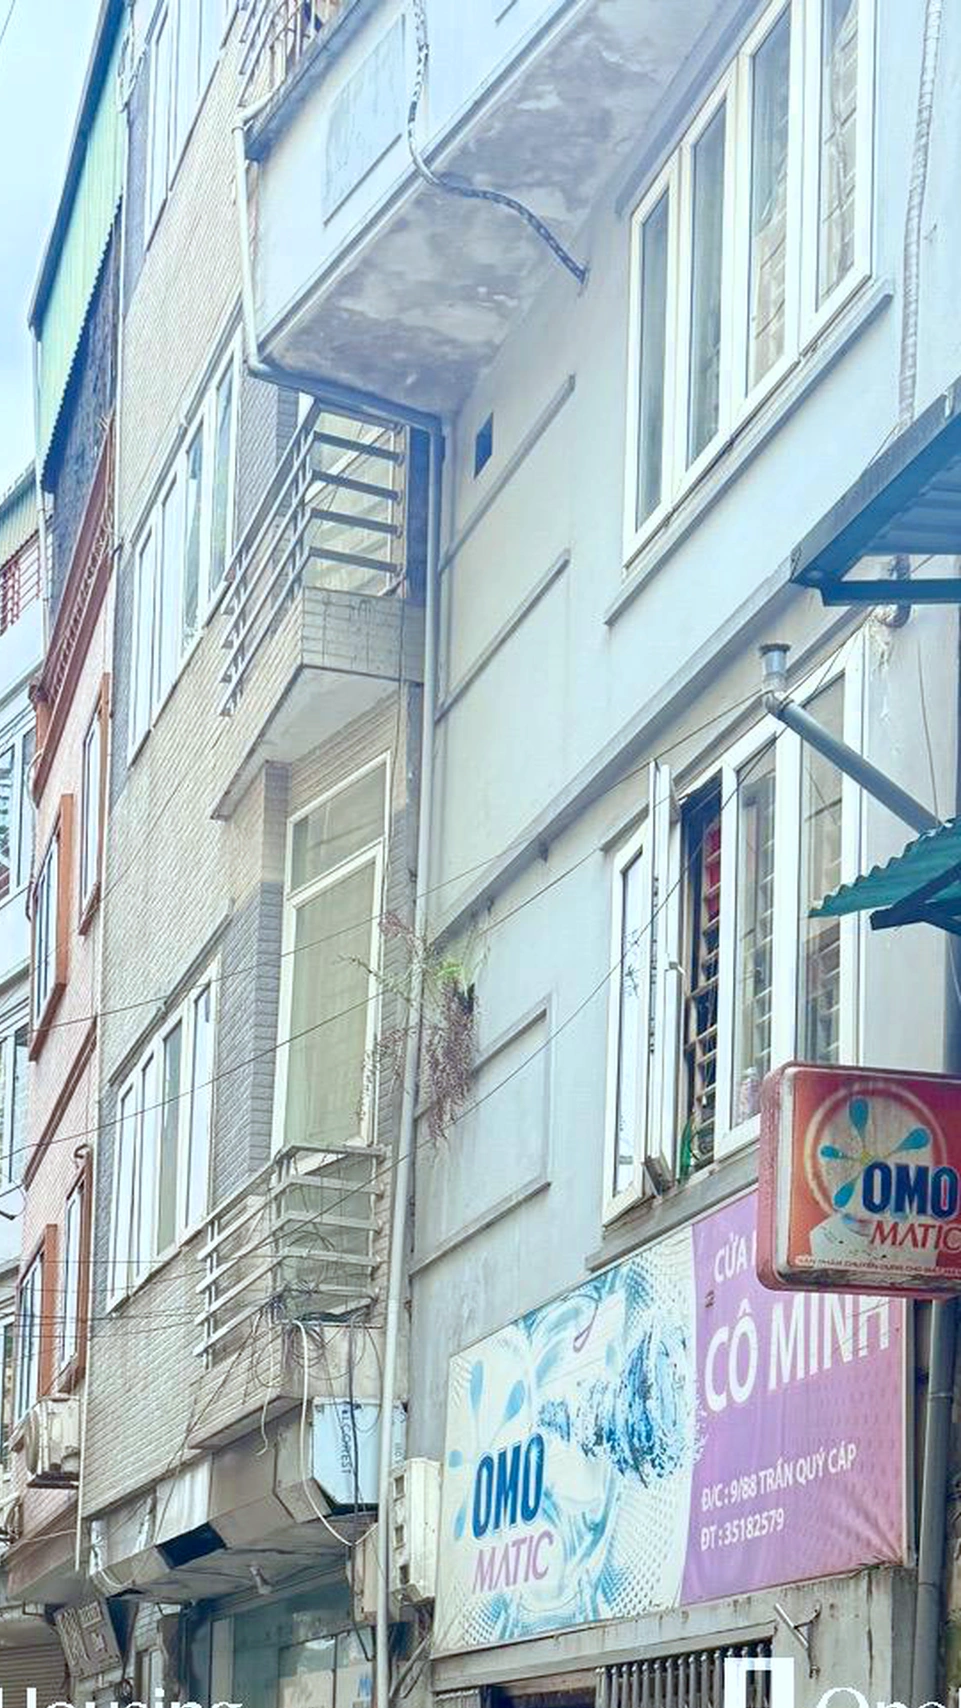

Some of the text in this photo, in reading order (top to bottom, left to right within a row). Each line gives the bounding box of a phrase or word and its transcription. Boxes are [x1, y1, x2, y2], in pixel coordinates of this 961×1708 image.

[861, 1160, 960, 1219] OMO
[714, 1232, 747, 1283] CỬA
[869, 1220, 961, 1251] MATIC
[704, 1292, 889, 1413] CÔ MINH
[472, 1433, 545, 1539] OMO
[472, 1529, 554, 1594] MATIC
